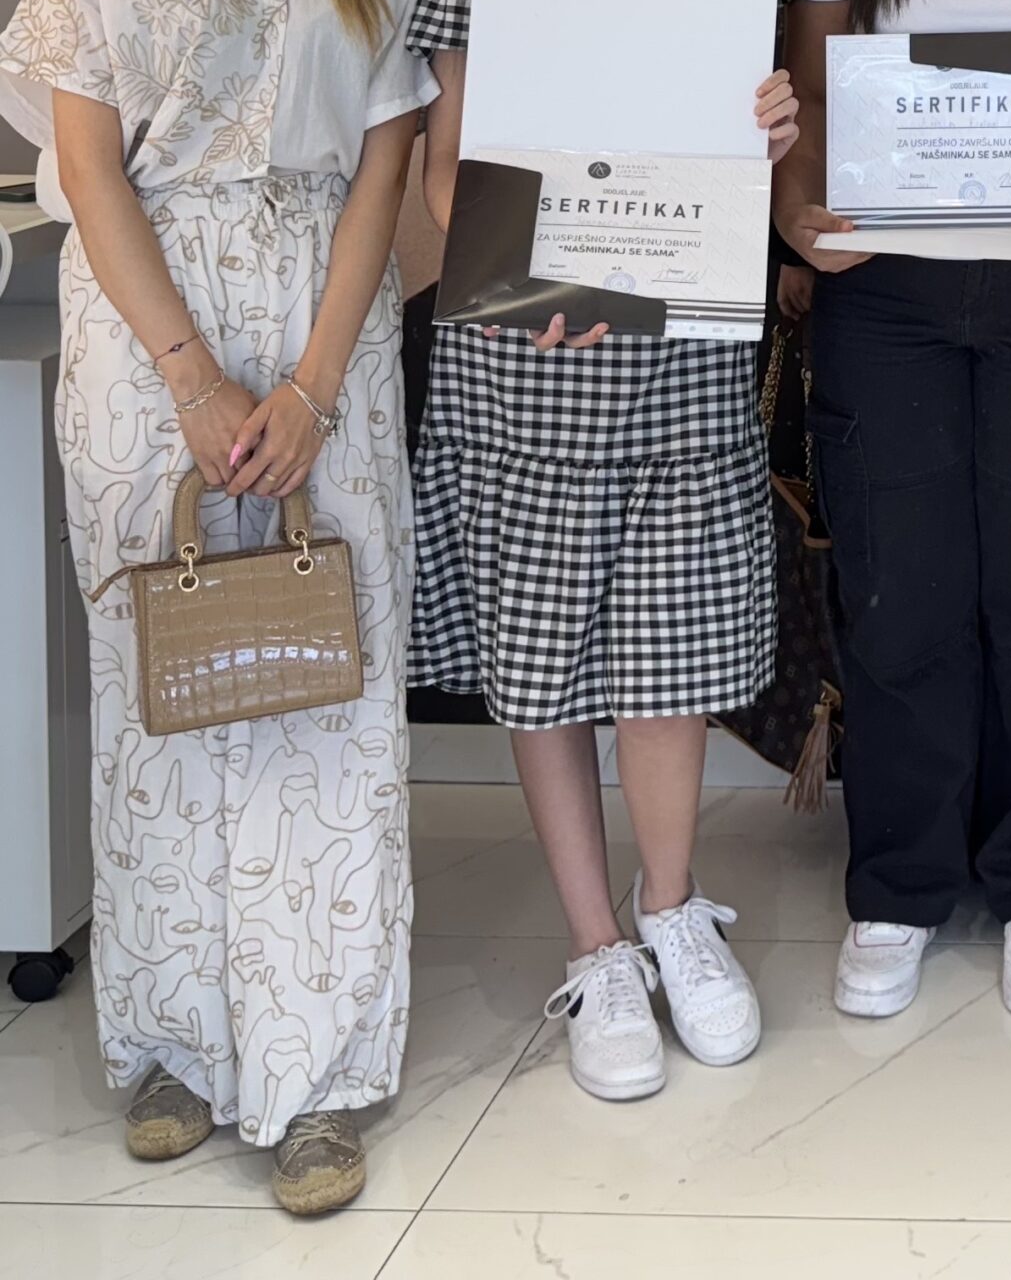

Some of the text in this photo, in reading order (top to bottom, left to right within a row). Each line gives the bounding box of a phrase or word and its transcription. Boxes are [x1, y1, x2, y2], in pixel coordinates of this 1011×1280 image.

[897, 139, 909, 148] ZA
[911, 138, 957, 148] USPJEŠNO
[978, 151, 990, 159] SE
[540, 197, 704, 219] SERTIFIKAT
[536, 233, 702, 248] ZA USPJEŠNO ZAVRŠENU OBUKU
